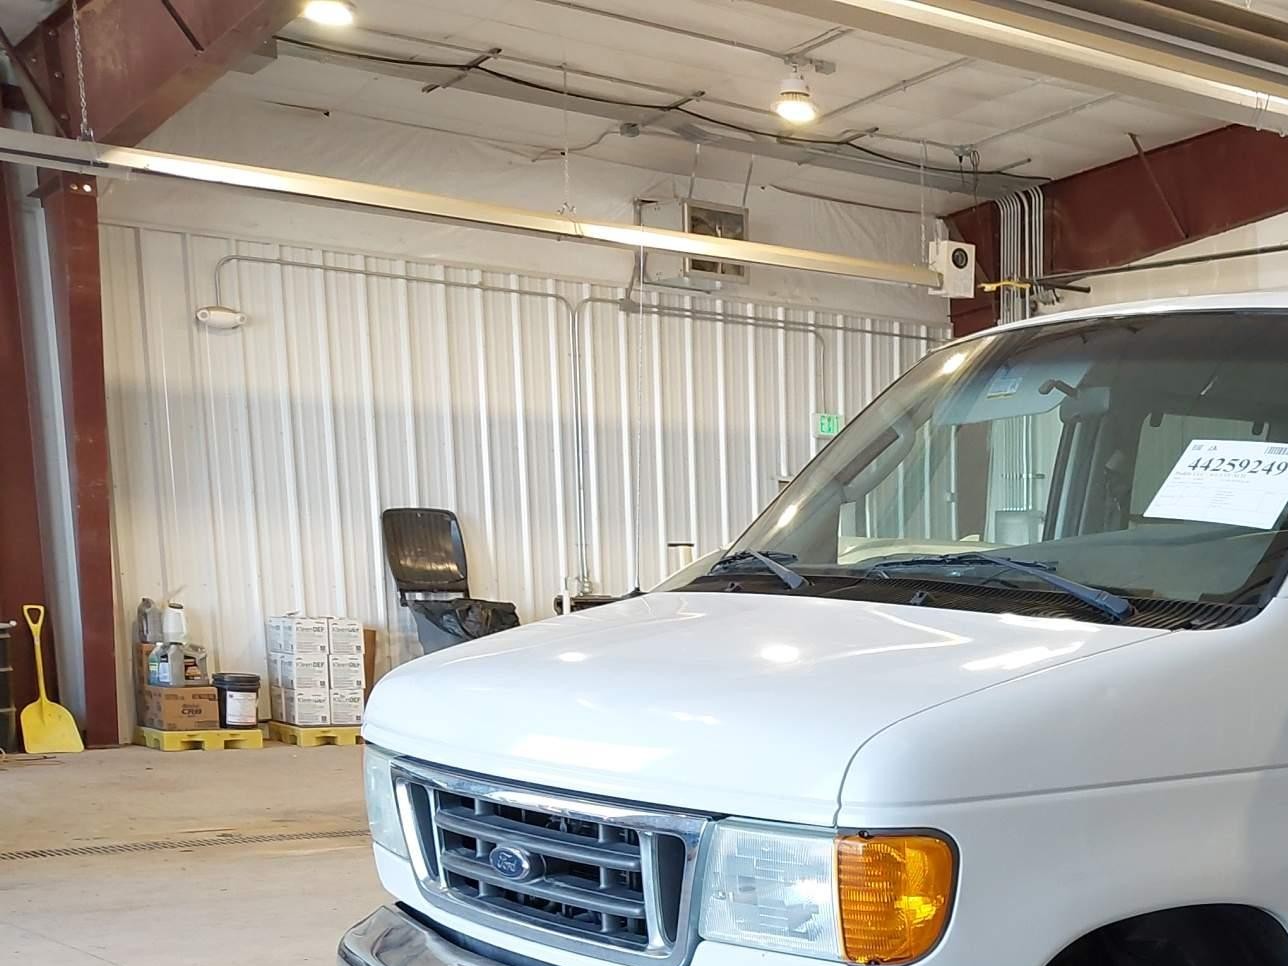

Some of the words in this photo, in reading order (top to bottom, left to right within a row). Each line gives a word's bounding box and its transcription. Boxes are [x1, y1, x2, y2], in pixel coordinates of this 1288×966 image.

[820, 415, 839, 433] EXIT
[1187, 457, 1288, 477] 44259249
[497, 851, 517, 872] Ford
